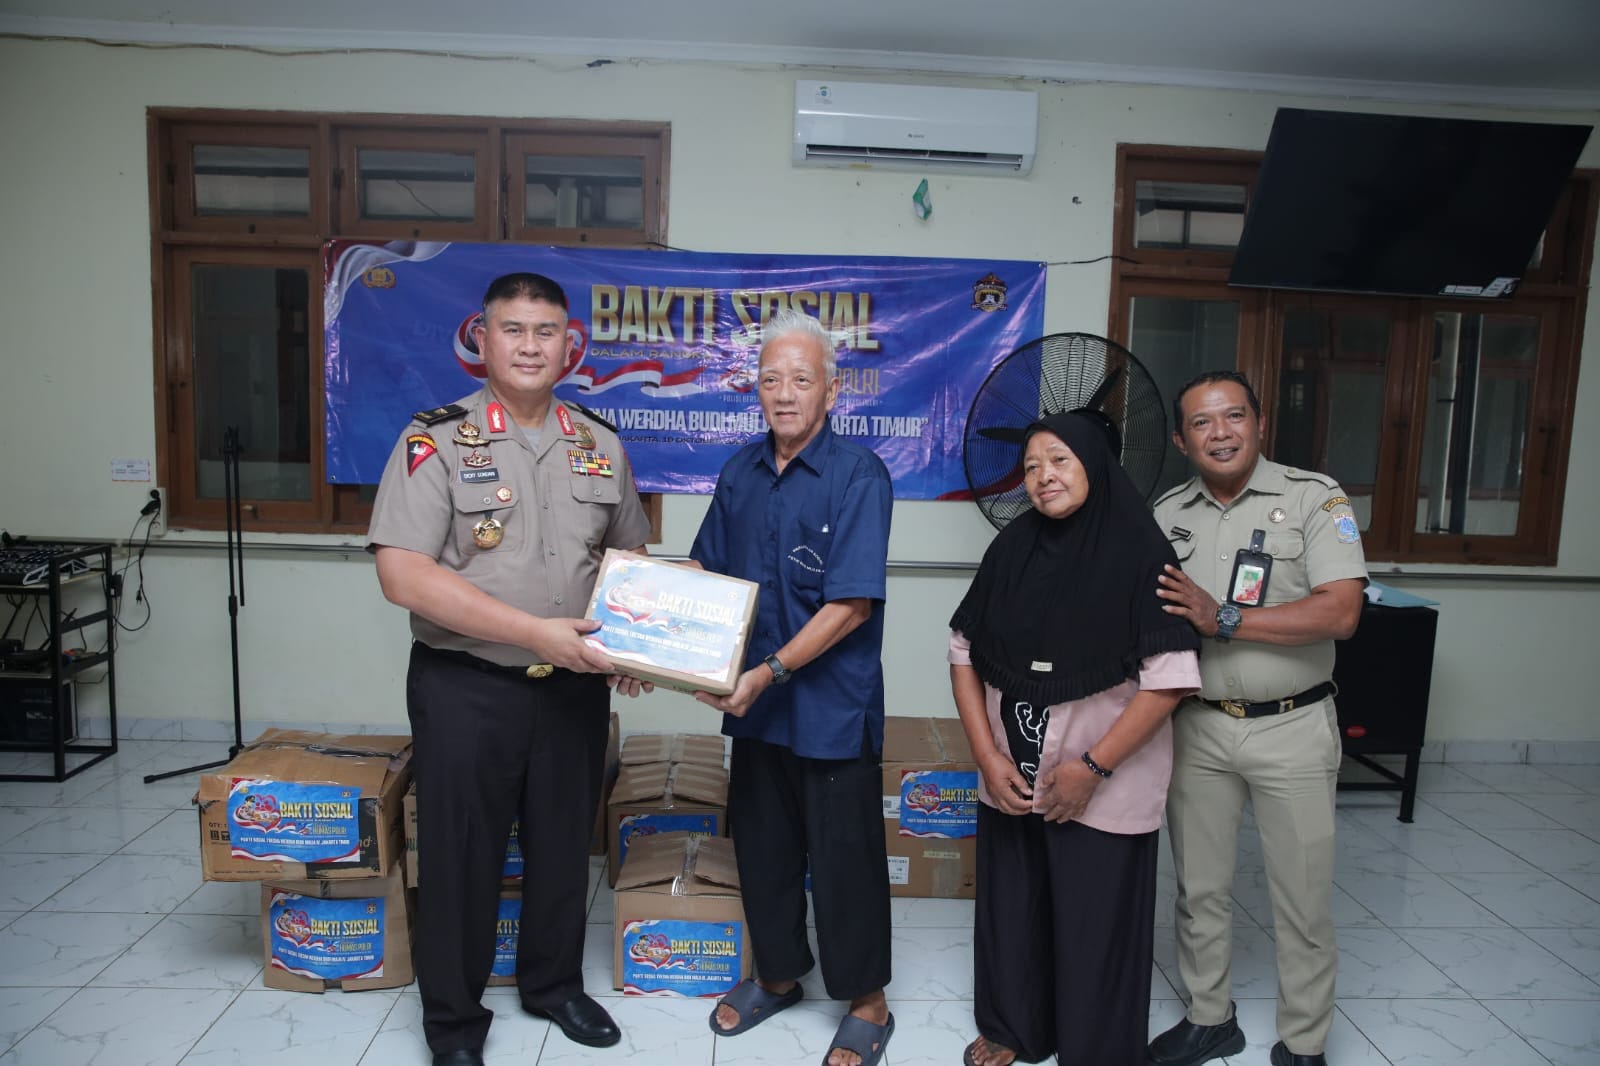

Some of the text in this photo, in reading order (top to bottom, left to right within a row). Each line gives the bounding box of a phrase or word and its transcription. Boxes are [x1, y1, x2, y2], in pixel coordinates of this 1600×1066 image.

[592, 284, 714, 344] BAKTI
[591, 348, 644, 357] DALAM
[618, 408, 687, 430] WERDHA
[688, 410, 724, 432] BUDI
[656, 591, 693, 616] BAKTI
[694, 599, 737, 627] SOSIAL
[940, 788, 964, 802] BAKTI
[279, 802, 354, 819] BAKTI SOSIAL
[311, 918, 380, 935] BAKTI SOSIAL
[671, 939, 737, 956] BAKTI SOSIAL
